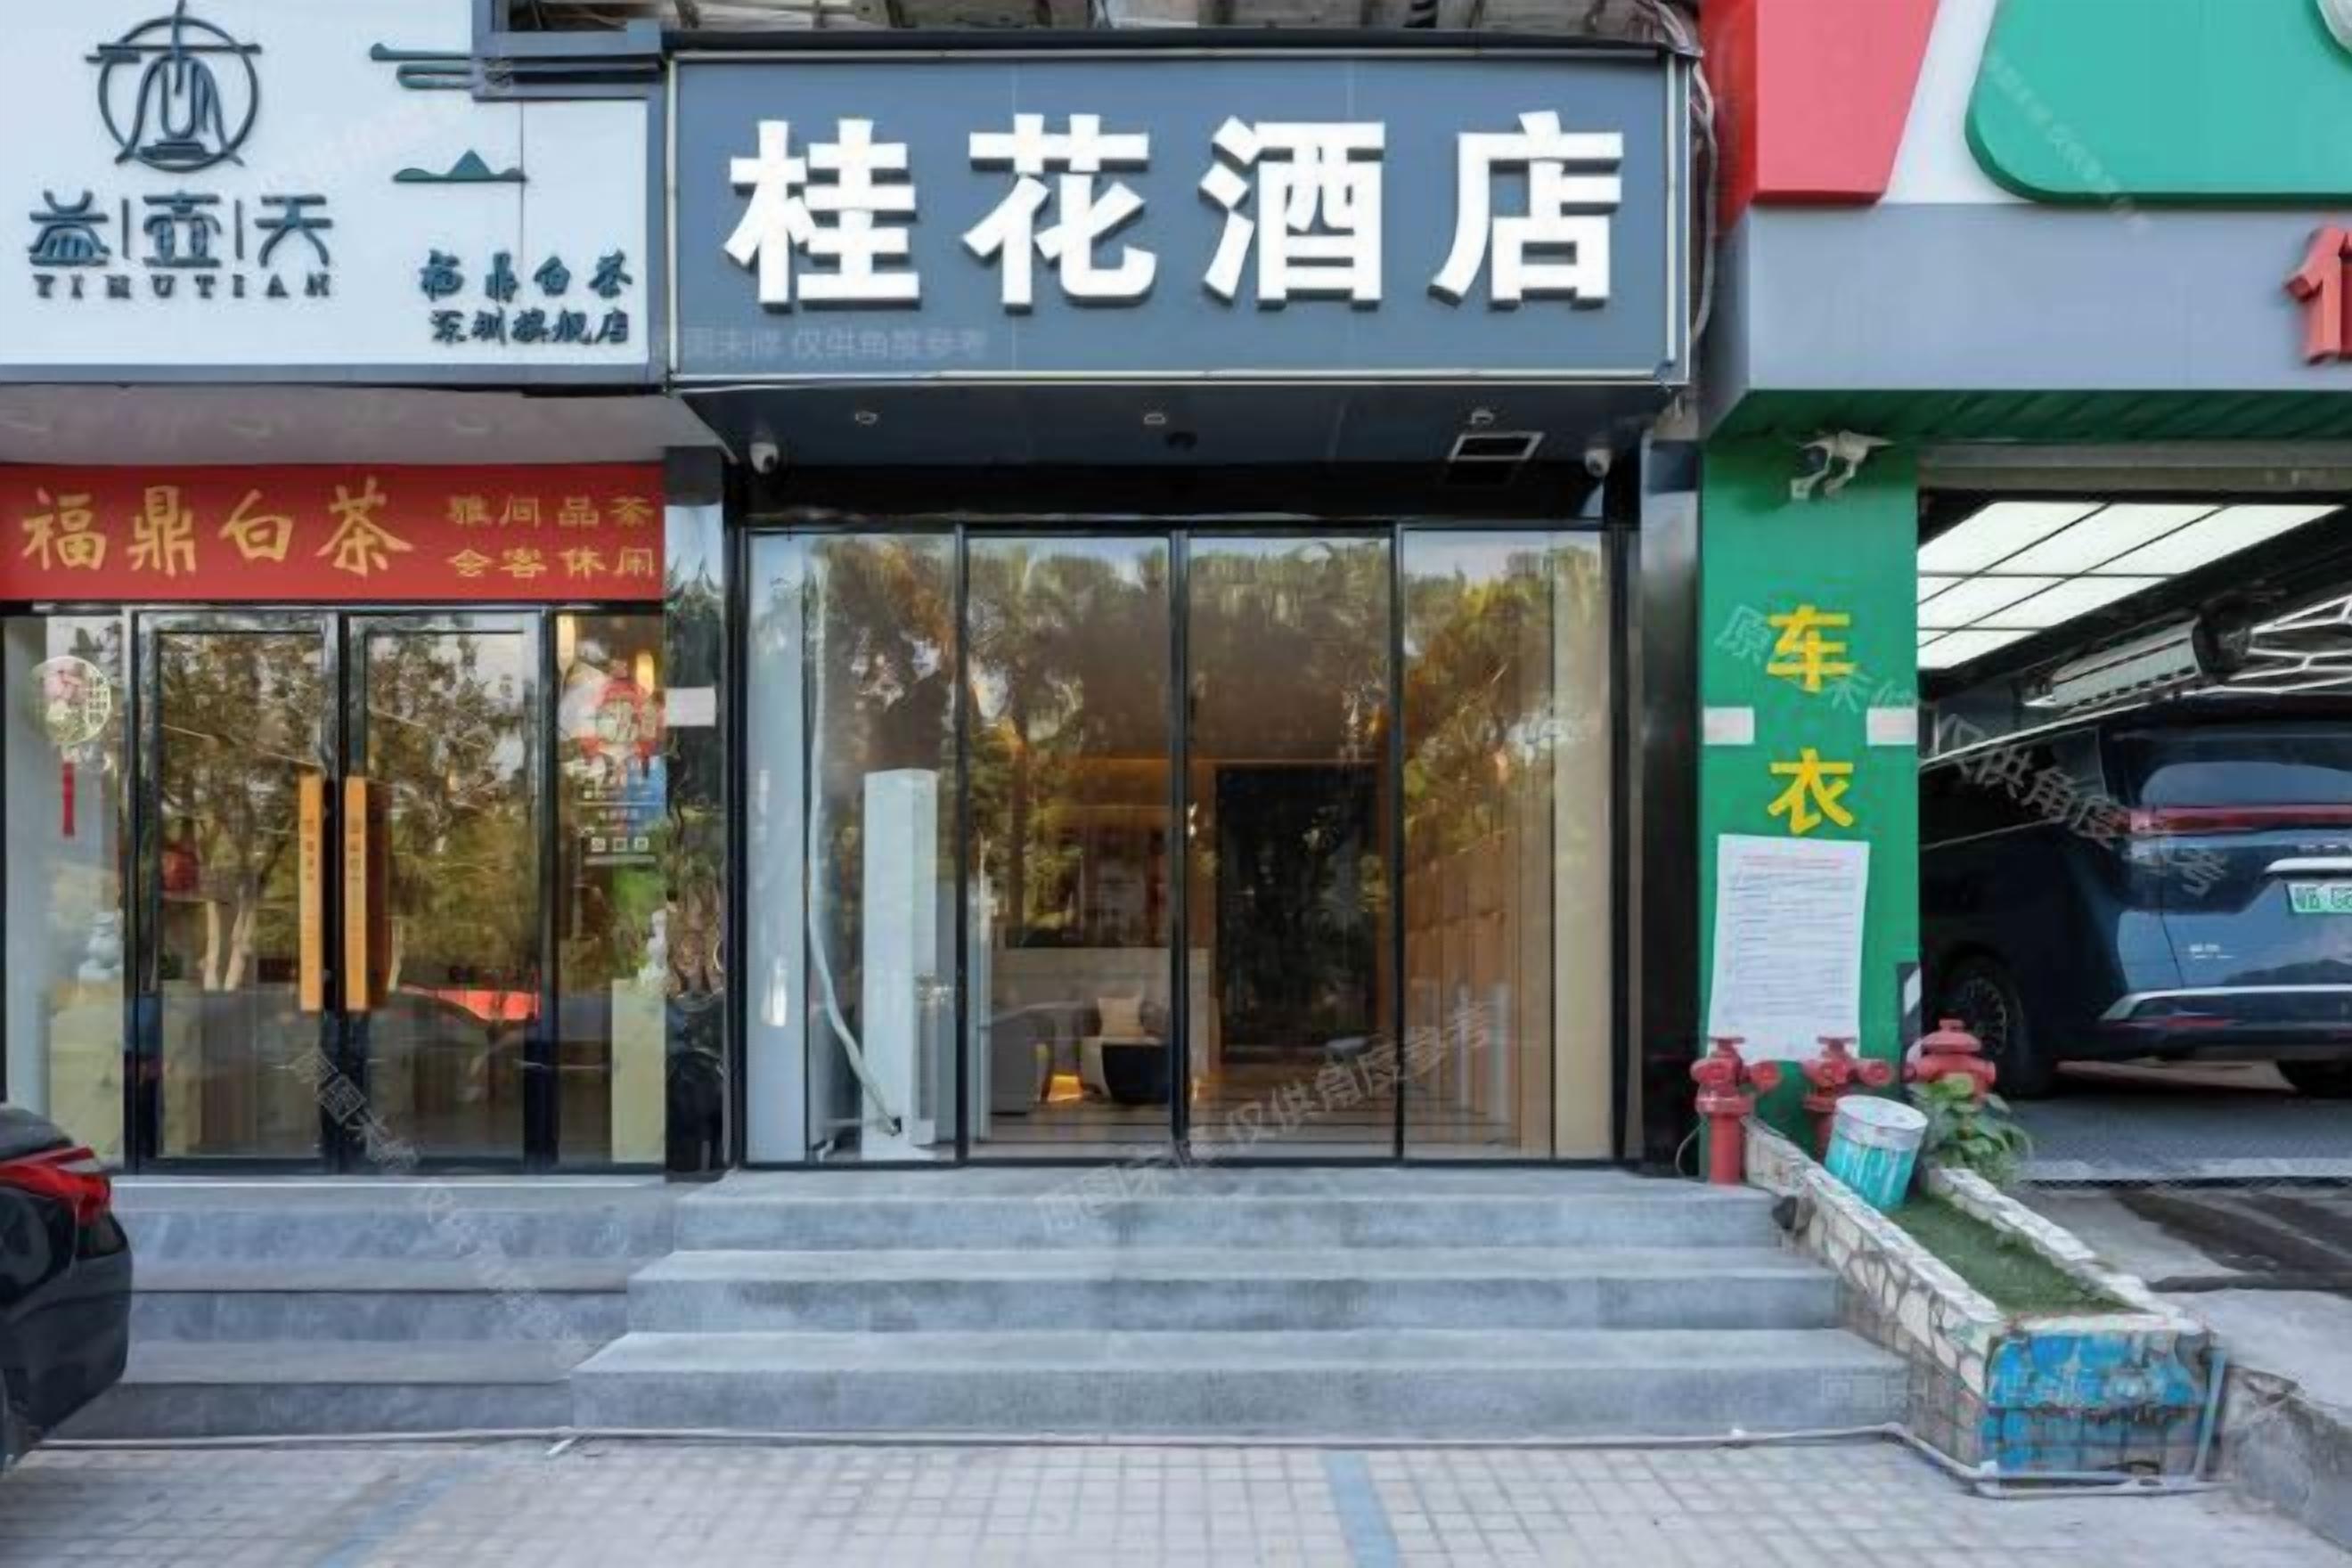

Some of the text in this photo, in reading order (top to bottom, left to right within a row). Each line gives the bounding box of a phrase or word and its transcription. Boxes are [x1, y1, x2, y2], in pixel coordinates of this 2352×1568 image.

[724, 110, 1624, 310] 桂花酒店
[420, 249, 633, 303] 福鼎白茶
[21, 477, 414, 577] 福鼎白茶
[447, 494, 656, 528] 雅间品茶
[446, 545, 657, 579] 会客休闲
[1767, 604, 1857, 835] 车衣
